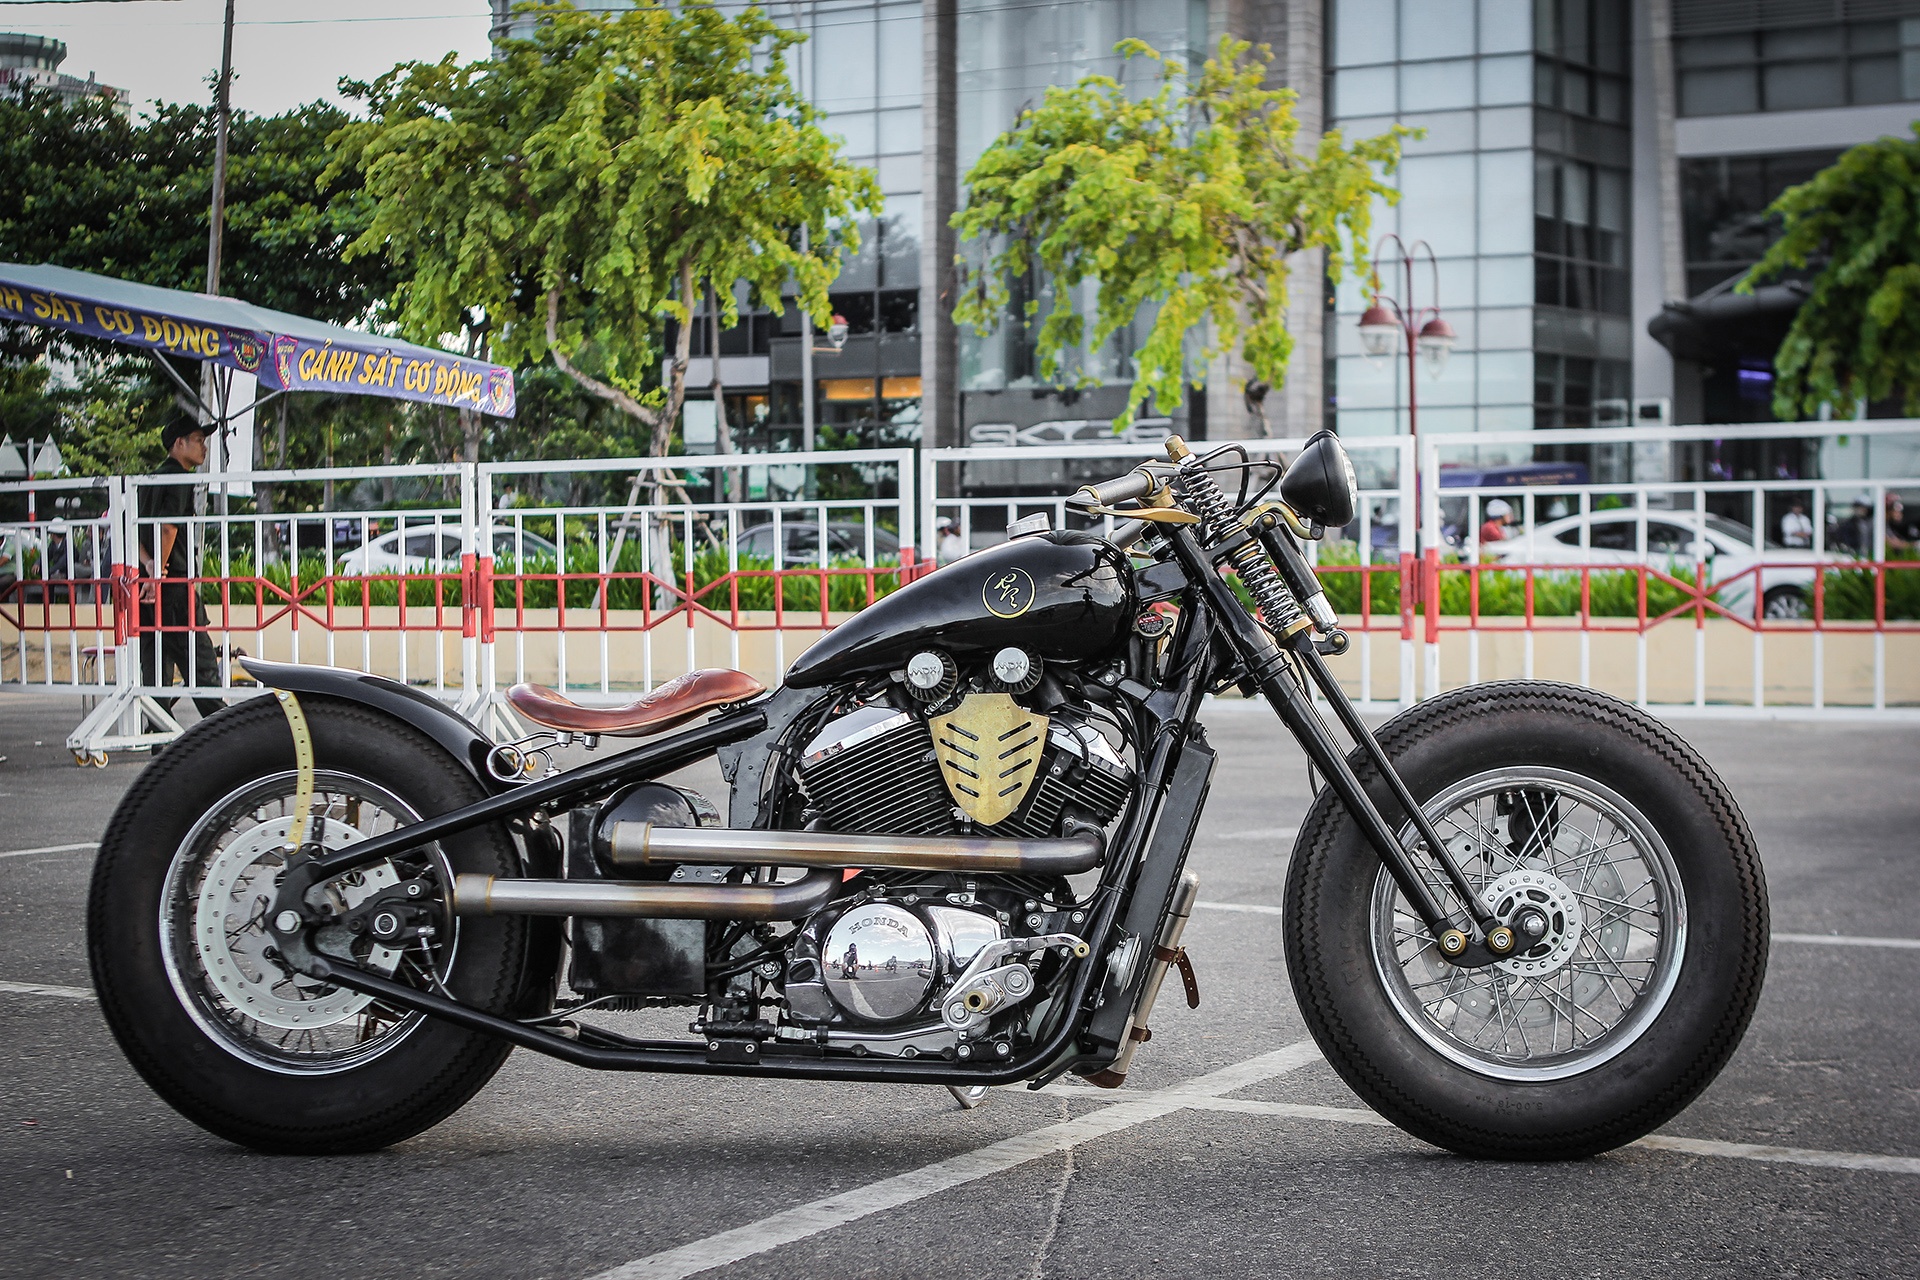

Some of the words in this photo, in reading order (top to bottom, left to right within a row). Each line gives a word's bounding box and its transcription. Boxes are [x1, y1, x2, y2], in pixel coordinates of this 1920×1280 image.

[30, 292, 84, 325] SÁT
[94, 306, 135, 335] CƠ
[141, 315, 220, 357] ĐỘNG
[298, 338, 359, 382] CẢNH
[358, 349, 403, 388] SÁT
[404, 359, 435, 393] CƠ
[433, 361, 483, 404] ĐỘNG
[848, 916, 909, 938] HONDA
